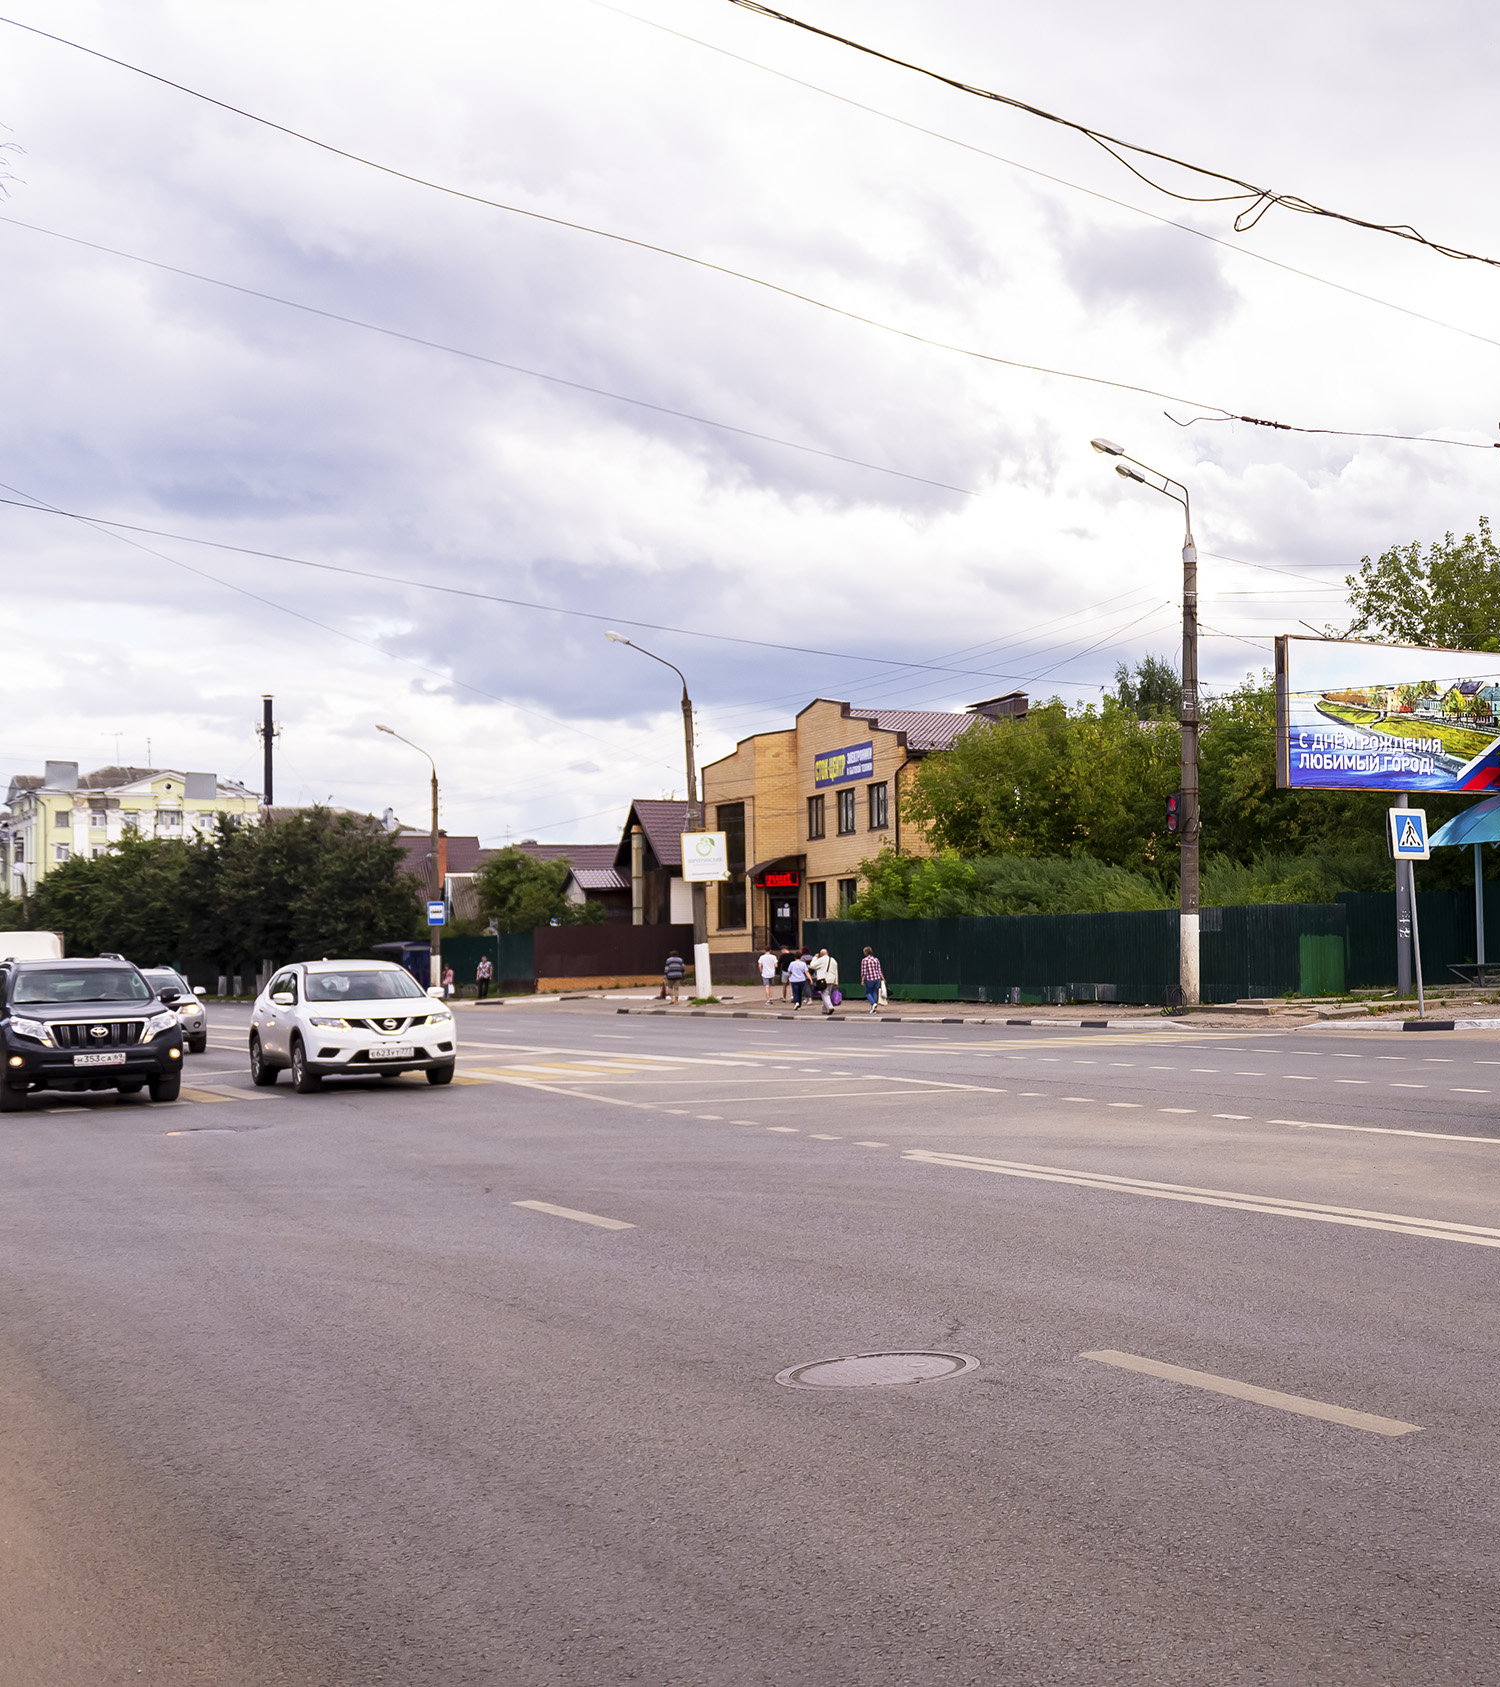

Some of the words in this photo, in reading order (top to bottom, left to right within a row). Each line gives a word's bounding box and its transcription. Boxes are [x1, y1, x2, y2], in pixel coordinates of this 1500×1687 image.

[1299, 733, 1309, 748] С
[1312, 732, 1356, 752] ДНЁМ
[1360, 735, 1446, 757] РОЖДЕНИЯ,
[1298, 753, 1380, 771] ЛЮБИМЫЙ
[1384, 757, 1435, 776] ГОРОД!
